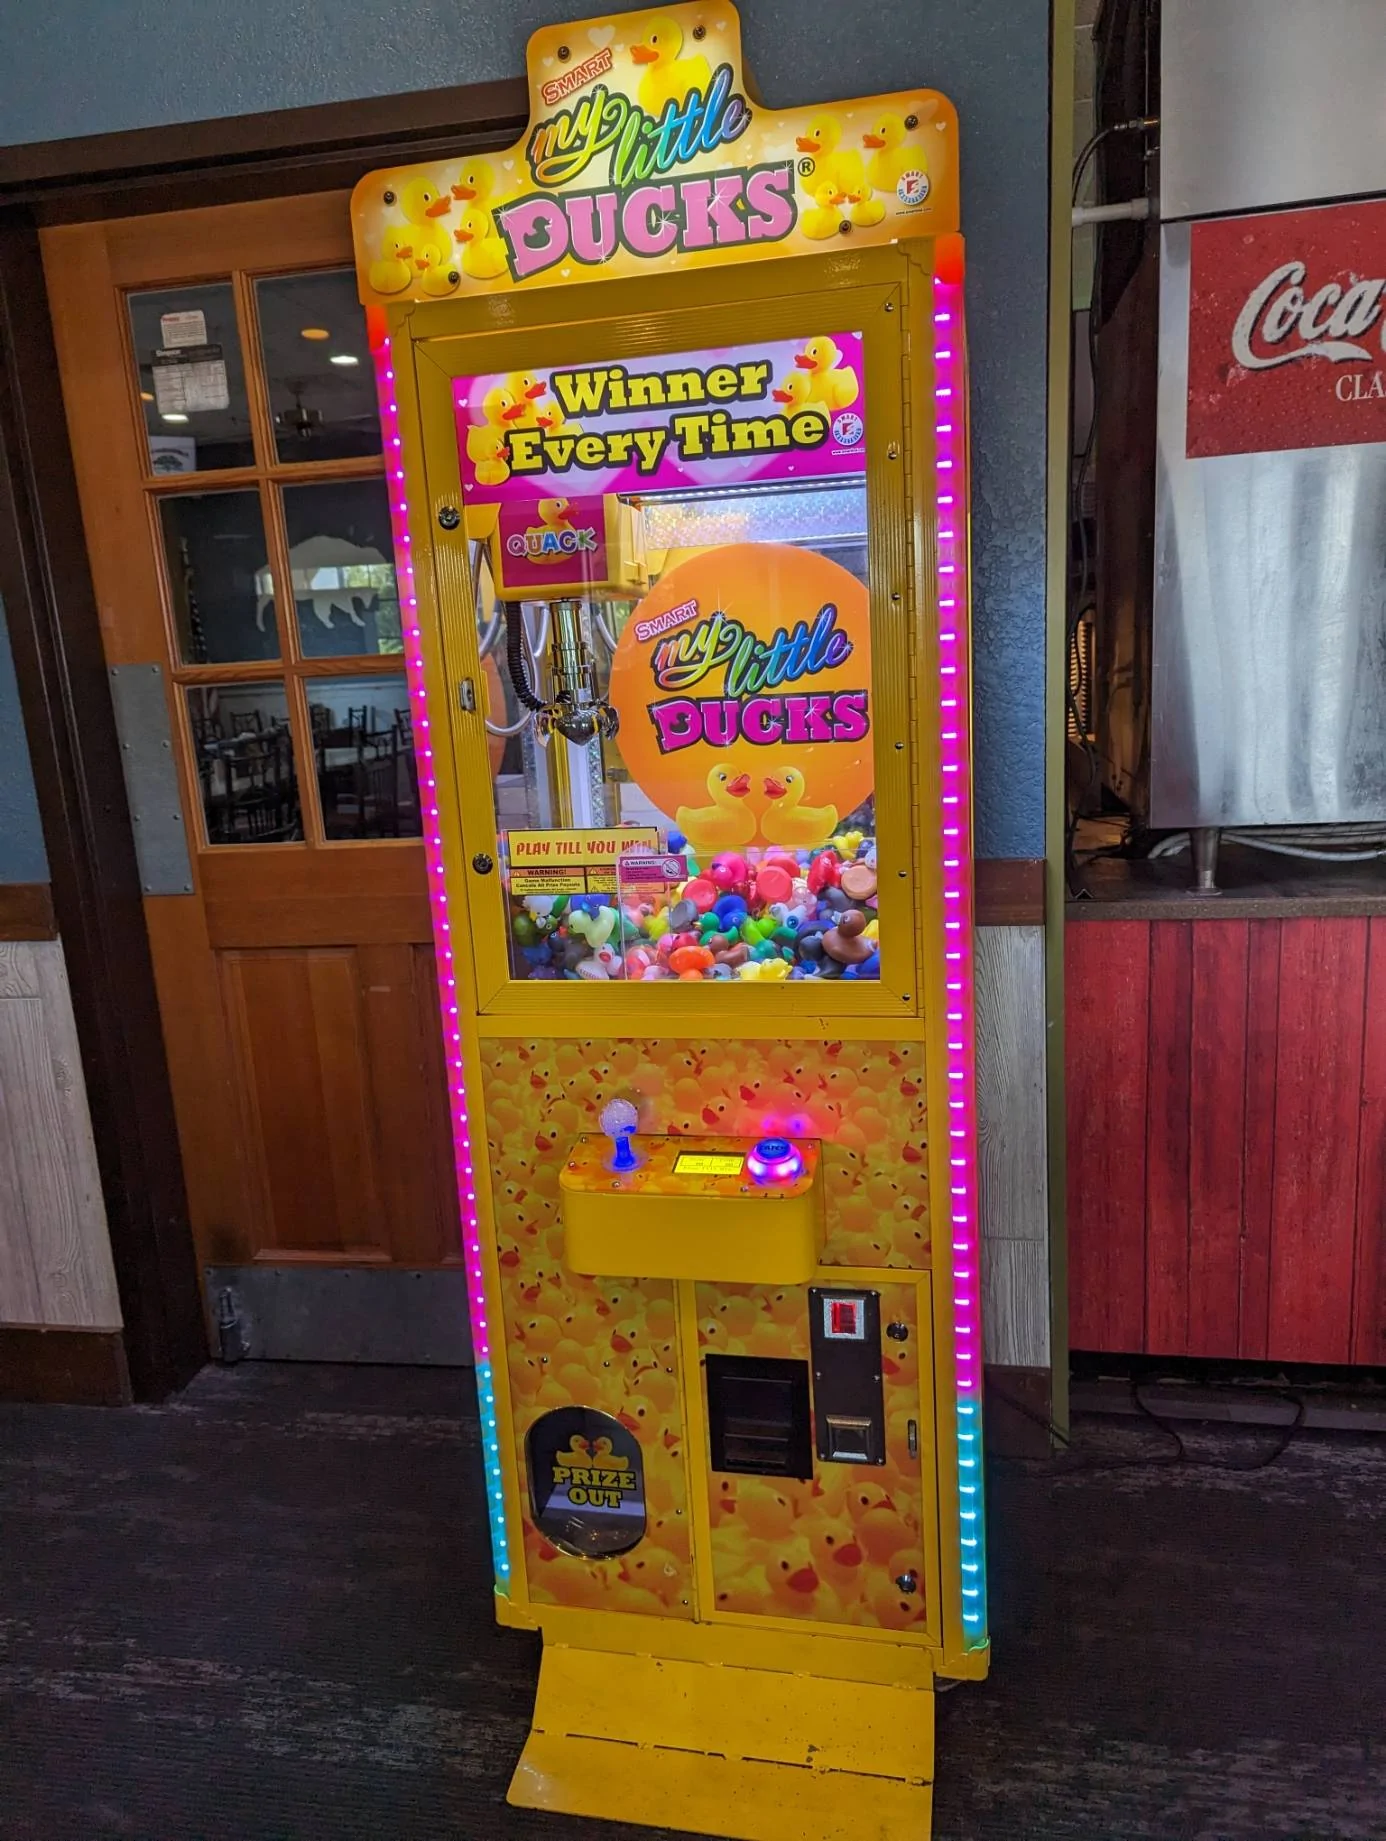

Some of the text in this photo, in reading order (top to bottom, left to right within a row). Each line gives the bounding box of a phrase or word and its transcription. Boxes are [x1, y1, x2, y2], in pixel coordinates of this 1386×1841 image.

[542, 48, 613, 105] SMART
[528, 65, 750, 186] my little
[495, 163, 795, 280] DUCKS
[553, 361, 769, 414] Winner
[508, 413, 825, 471] Every Time
[507, 527, 598, 556] QUACK
[635, 600, 697, 641] SMART
[653, 604, 852, 697] my little
[649, 692, 869, 753] DUCKS
[516, 842, 550, 856] PLAY
[555, 842, 582, 855] TILL
[587, 840, 615, 854] YOU
[552, 1466, 636, 1490] PRIZE
[568, 1486, 622, 1508] OUT
